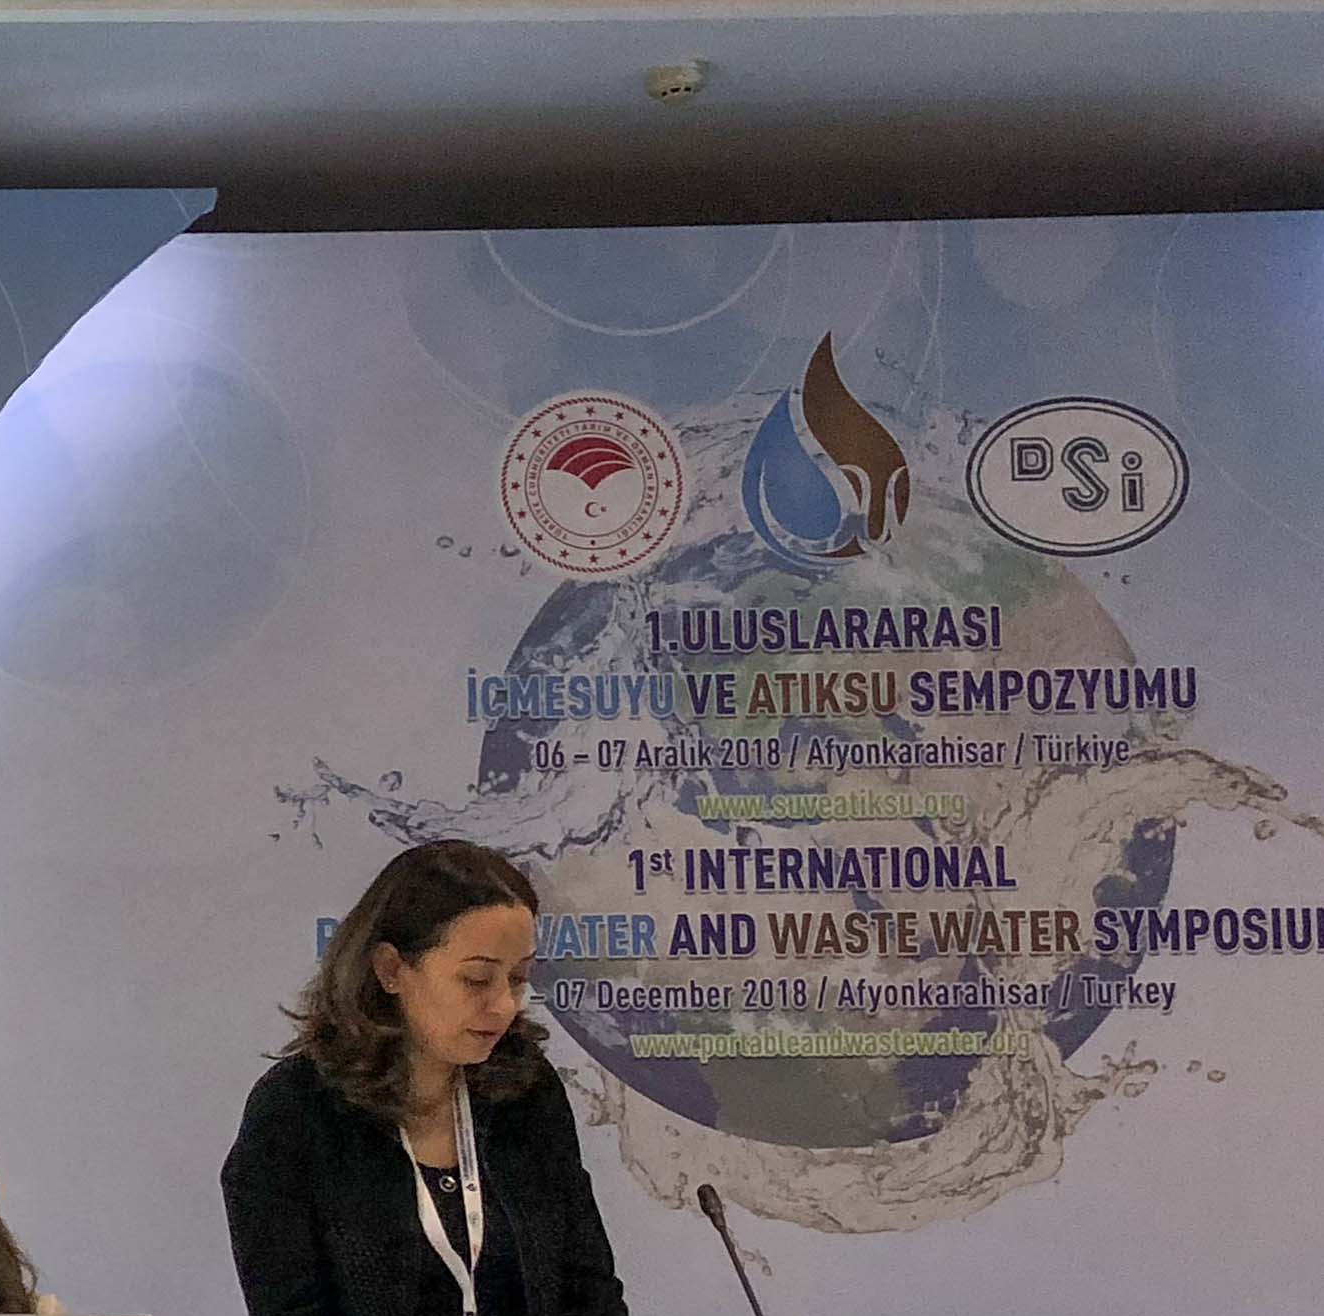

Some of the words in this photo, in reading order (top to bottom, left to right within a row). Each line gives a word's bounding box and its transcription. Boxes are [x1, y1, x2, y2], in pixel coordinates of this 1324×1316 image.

[644, 606, 1002, 651] 1.ULUSLARARASI
[466, 667, 675, 729] İÇMESUYU
[686, 673, 738, 715] VE
[748, 671, 897, 714] ATIKSU
[910, 667, 1198, 711] SEMPOZYUMU
[535, 740, 565, 768] 06
[598, 740, 627, 767] 07
[635, 738, 712, 767] Aralık
[720, 738, 781, 767] 2018
[807, 735, 1005, 770] Afyonkarahisar
[1032, 735, 1130, 767] Türkiye
[698, 790, 966, 822] www.suveatiksu.org
[684, 846, 1017, 890] INTERNATIONAL
[669, 914, 756, 955] AND
[767, 911, 919, 954] WASTE
[930, 910, 1081, 952] WATER
[556, 980, 587, 1009] 07
[598, 978, 732, 1008] December
[744, 976, 807, 1007] 2018
[838, 973, 1051, 1012] Afyonkarahisar
[1082, 976, 1176, 1011] Turkey
[630, 1028, 1032, 1062] www.portableandwastewater.org
